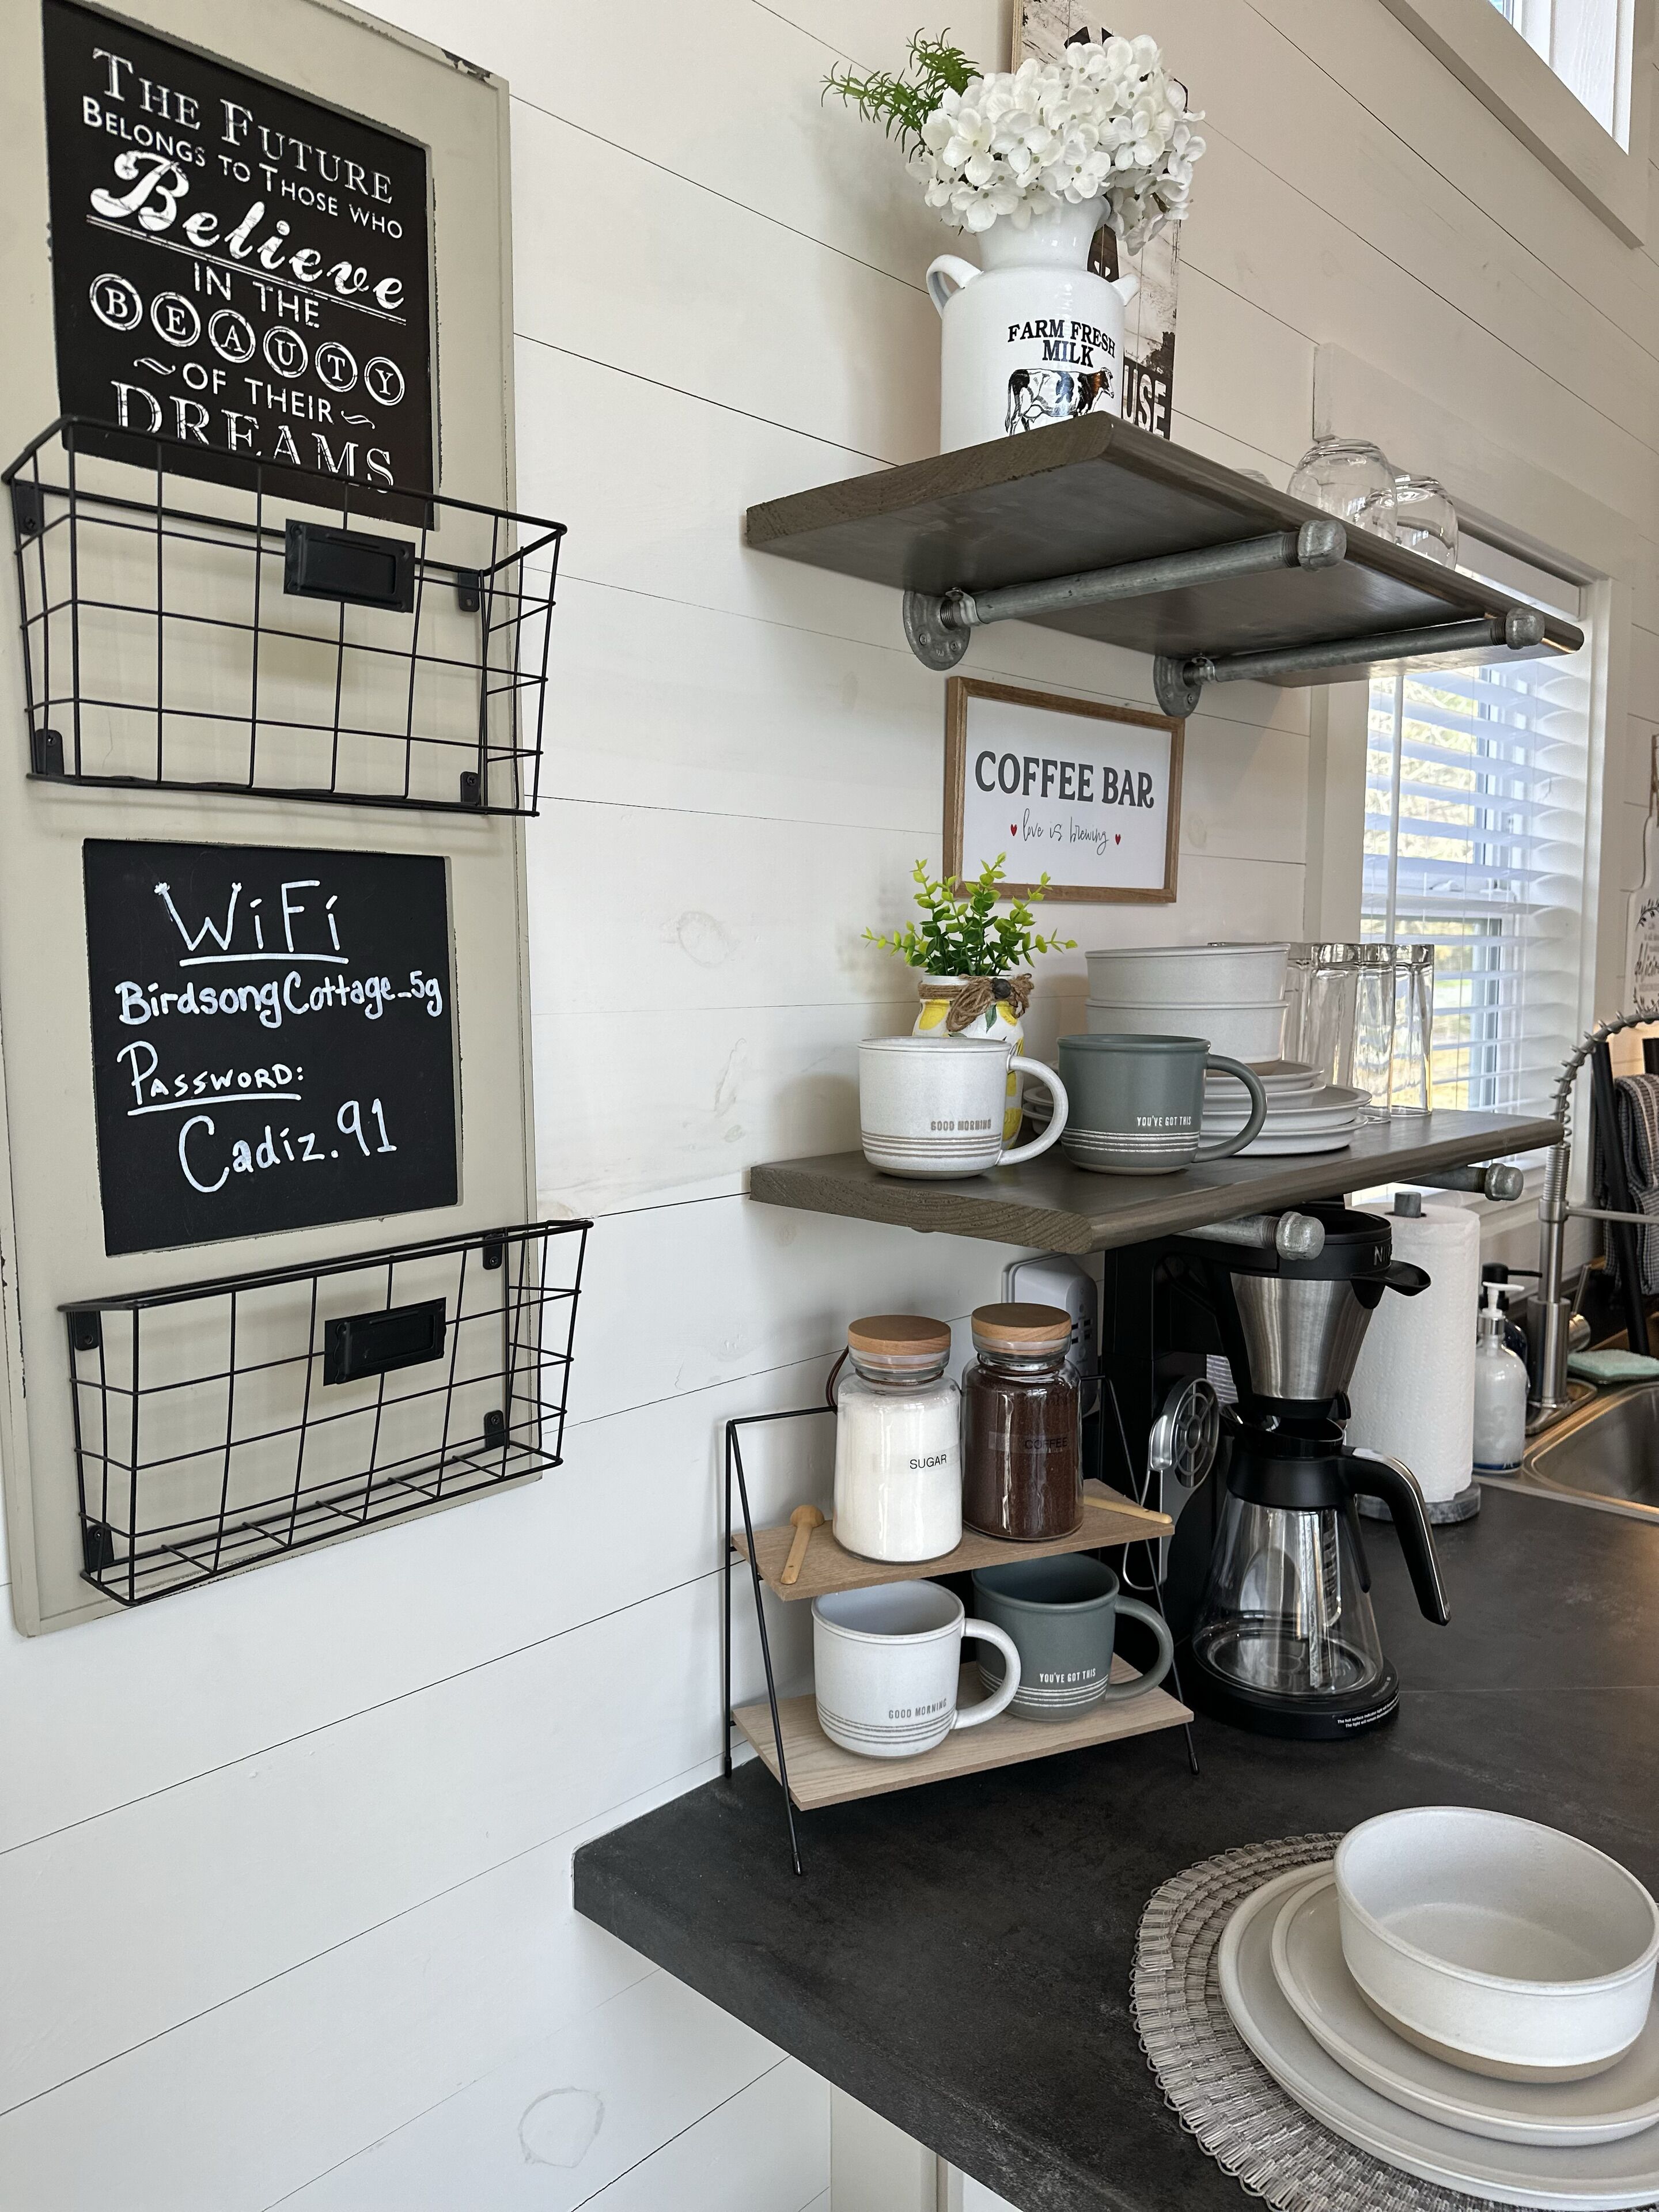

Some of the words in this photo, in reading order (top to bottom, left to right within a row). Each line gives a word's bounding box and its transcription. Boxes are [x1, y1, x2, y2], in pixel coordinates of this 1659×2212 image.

[83, 96, 206, 167] BELONGS
[219, 155, 251, 183] TO
[259, 162, 338, 216] THOSE
[349, 203, 402, 239] WHO
[220, 99, 392, 204] FUTURE
[90, 150, 404, 310] Believe
[194, 262, 230, 300] IN
[252, 281, 320, 328] THE
[98, 281, 399, 400] BEAUTY
[1007, 319, 1065, 342] FARM
[1070, 321, 1116, 358] FRESH
[1042, 340, 1093, 368] MILK
[183, 362, 226, 395] OF
[245, 377, 333, 423] THEIR
[111, 381, 395, 494] DREAMS
[975, 751, 1093, 802] COFFEE
[1101, 767, 1154, 808] BAR
[1023, 808, 1044, 841] love
[1050, 821, 1063, 841] is
[1070, 816, 1109, 855] brewing
[154, 880, 339, 952] WiFi
[179, 1099, 397, 1192] Cadiz.91
[930, 1120, 955, 1131] GOOD
[957, 1119, 991, 1131] MORNING
[1137, 1115, 1162, 1127] YOU'VE
[1165, 1116, 1177, 1126] GOT
[1179, 1116, 1191, 1126] THIS
[910, 1453, 948, 1470] SUGAR
[1025, 1437, 1068, 1450] COFFEE
[1039, 1672, 1065, 1683] YOU'VE
[1067, 1672, 1081, 1682] GOT
[1082, 1668, 1096, 1680] THIS
[889, 1709, 911, 1719] GOOD
[915, 1698, 946, 1717] MORNING
